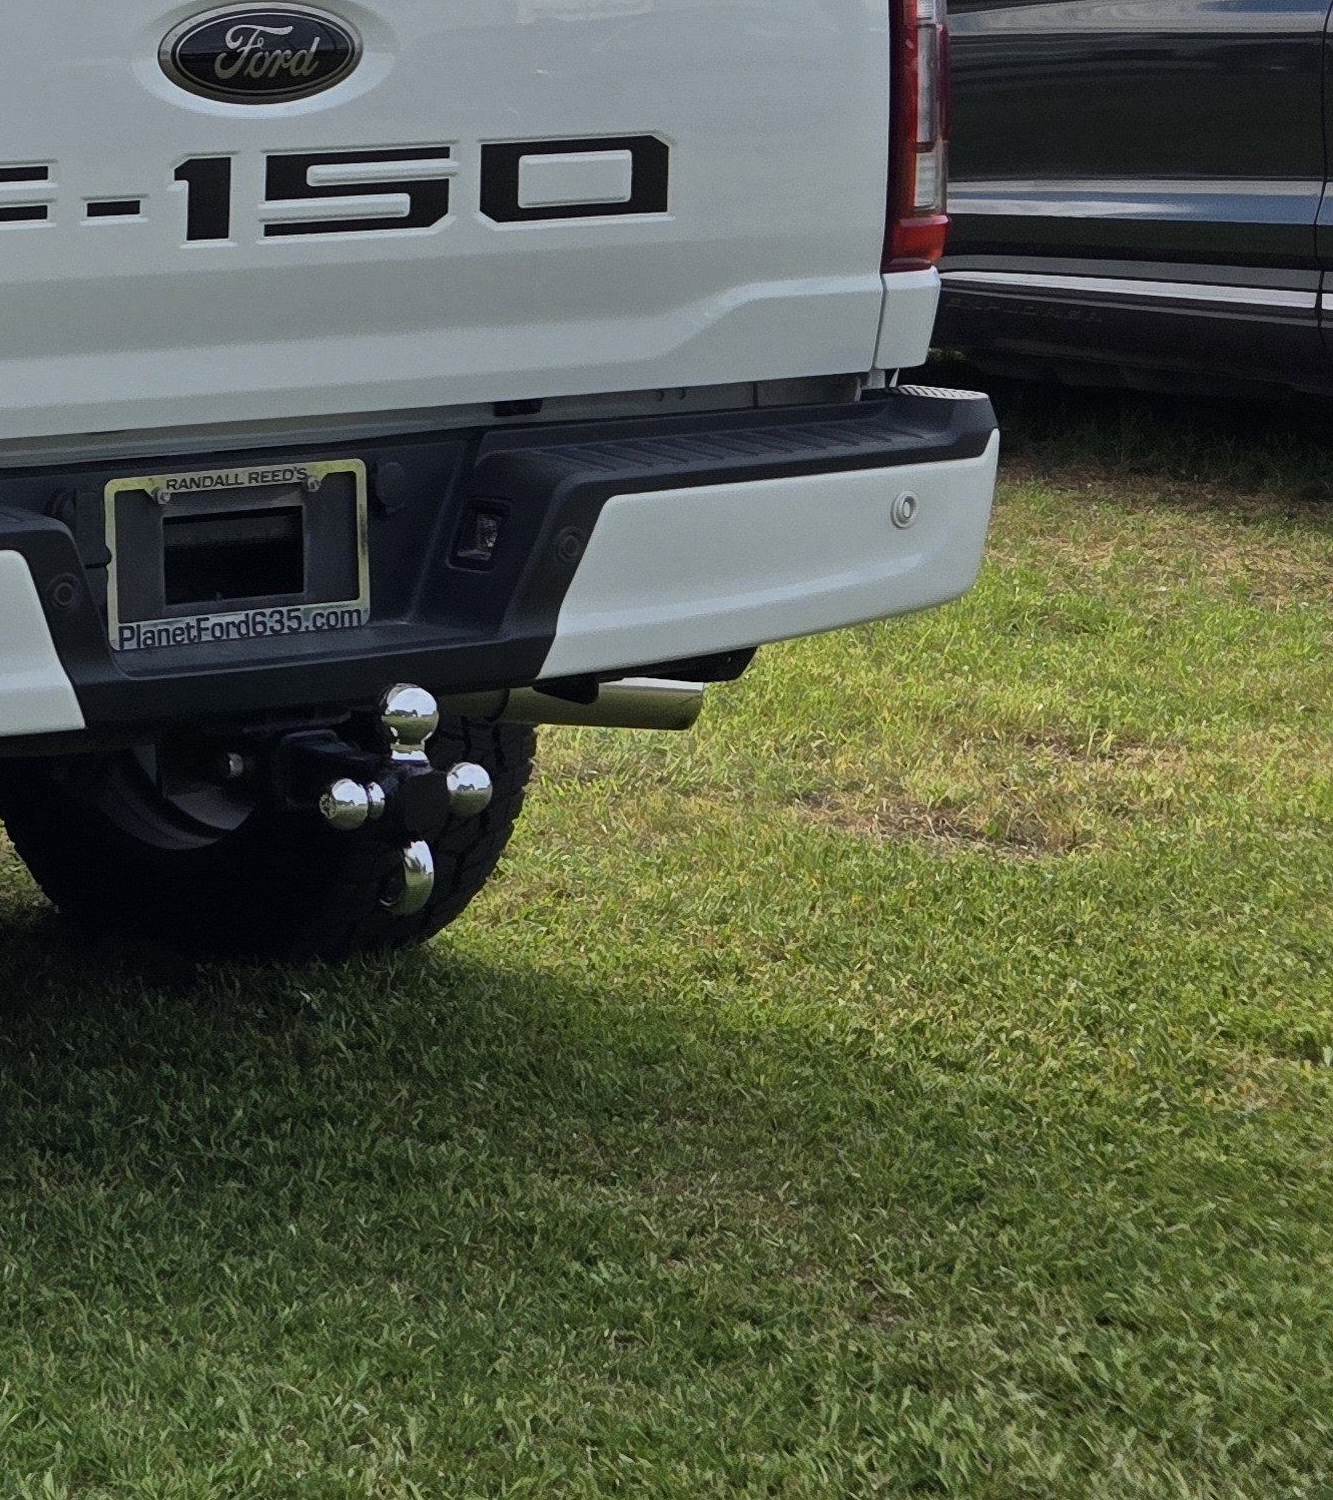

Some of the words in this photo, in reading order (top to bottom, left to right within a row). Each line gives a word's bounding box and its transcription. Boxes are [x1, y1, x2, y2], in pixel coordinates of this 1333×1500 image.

[214, 24, 321, 80] Ford
[165, 473, 244, 491] RANDALL
[248, 467, 308, 484] REED'S
[118, 608, 362, 649] PlanetFord635.com
